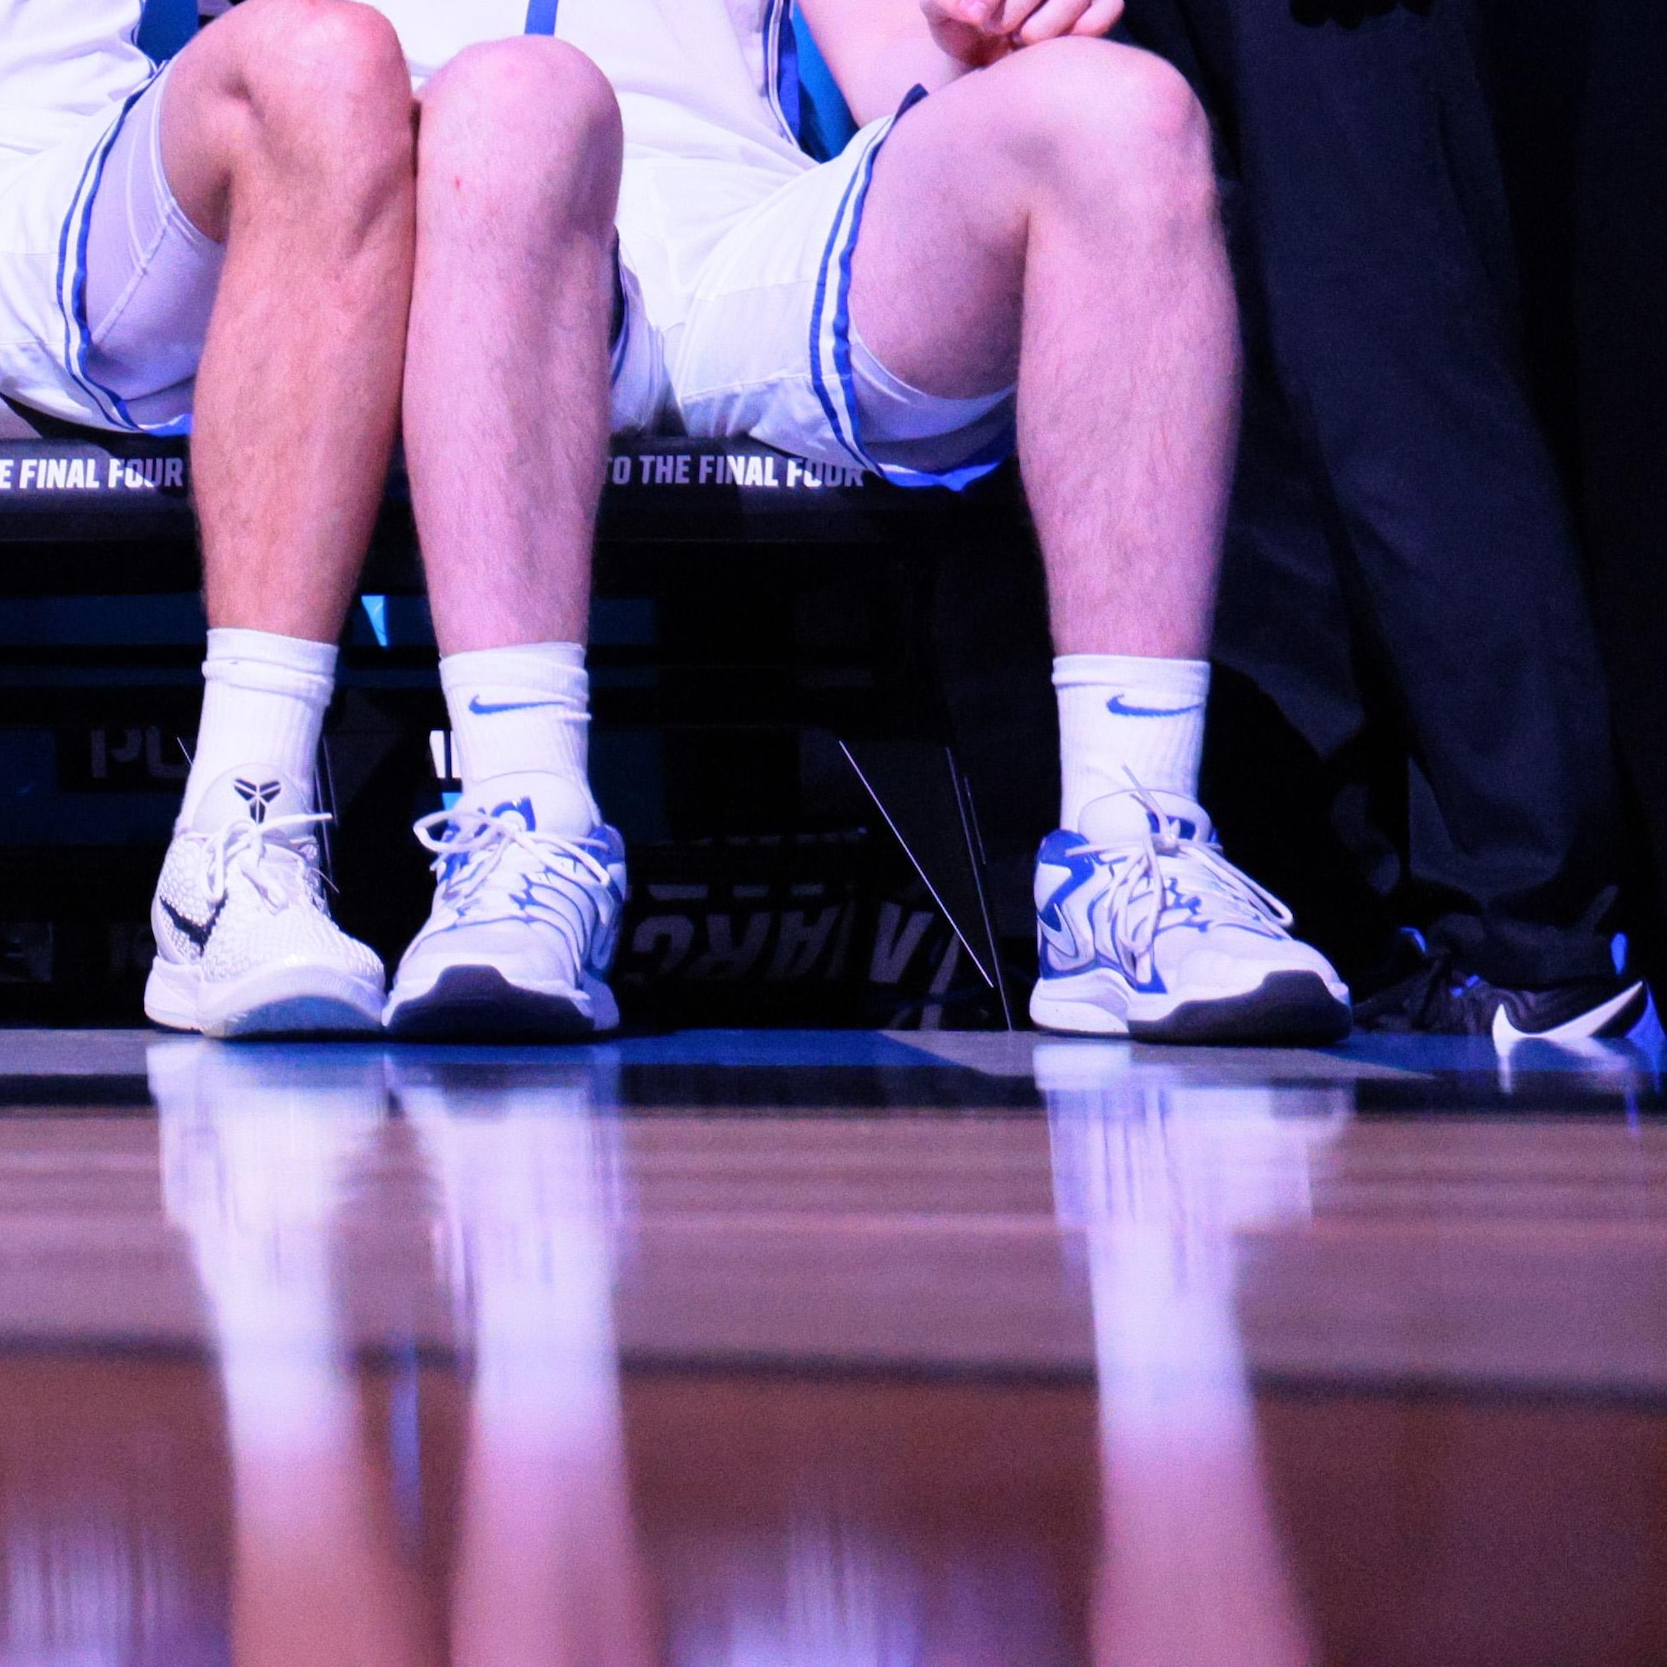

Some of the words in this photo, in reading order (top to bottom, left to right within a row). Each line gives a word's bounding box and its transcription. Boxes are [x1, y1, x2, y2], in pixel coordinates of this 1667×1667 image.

[19, 459, 100, 489] FINAL
[109, 457, 184, 488] FOUR
[638, 454, 691, 485] THE
[698, 455, 780, 487] FINAL
